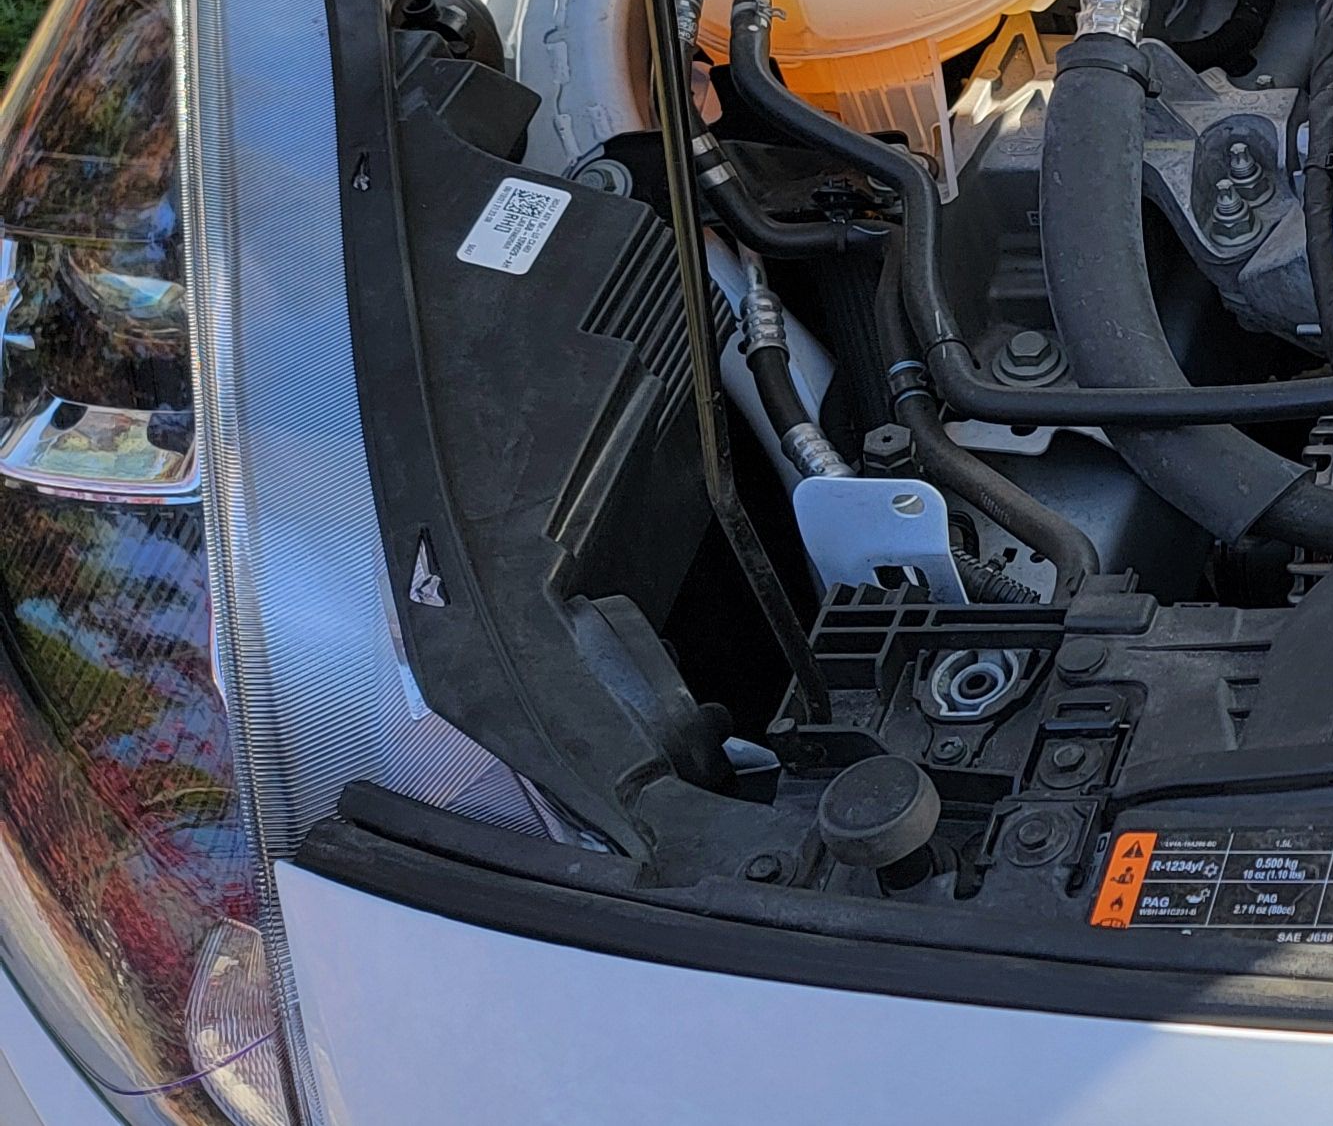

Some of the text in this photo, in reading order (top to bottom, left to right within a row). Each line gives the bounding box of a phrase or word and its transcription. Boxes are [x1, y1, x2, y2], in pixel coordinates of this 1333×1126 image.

[1151, 859, 1206, 874] R-1234yf
[1255, 858, 1299, 871] 0.500 kg
[1141, 896, 1170, 908] PAG
[1256, 894, 1278, 904] PAG
[1233, 904, 1248, 914] 2.7
[1256, 905, 1267, 914] oz
[1276, 932, 1302, 943] SAE
[1306, 932, 1333, 943] J639
